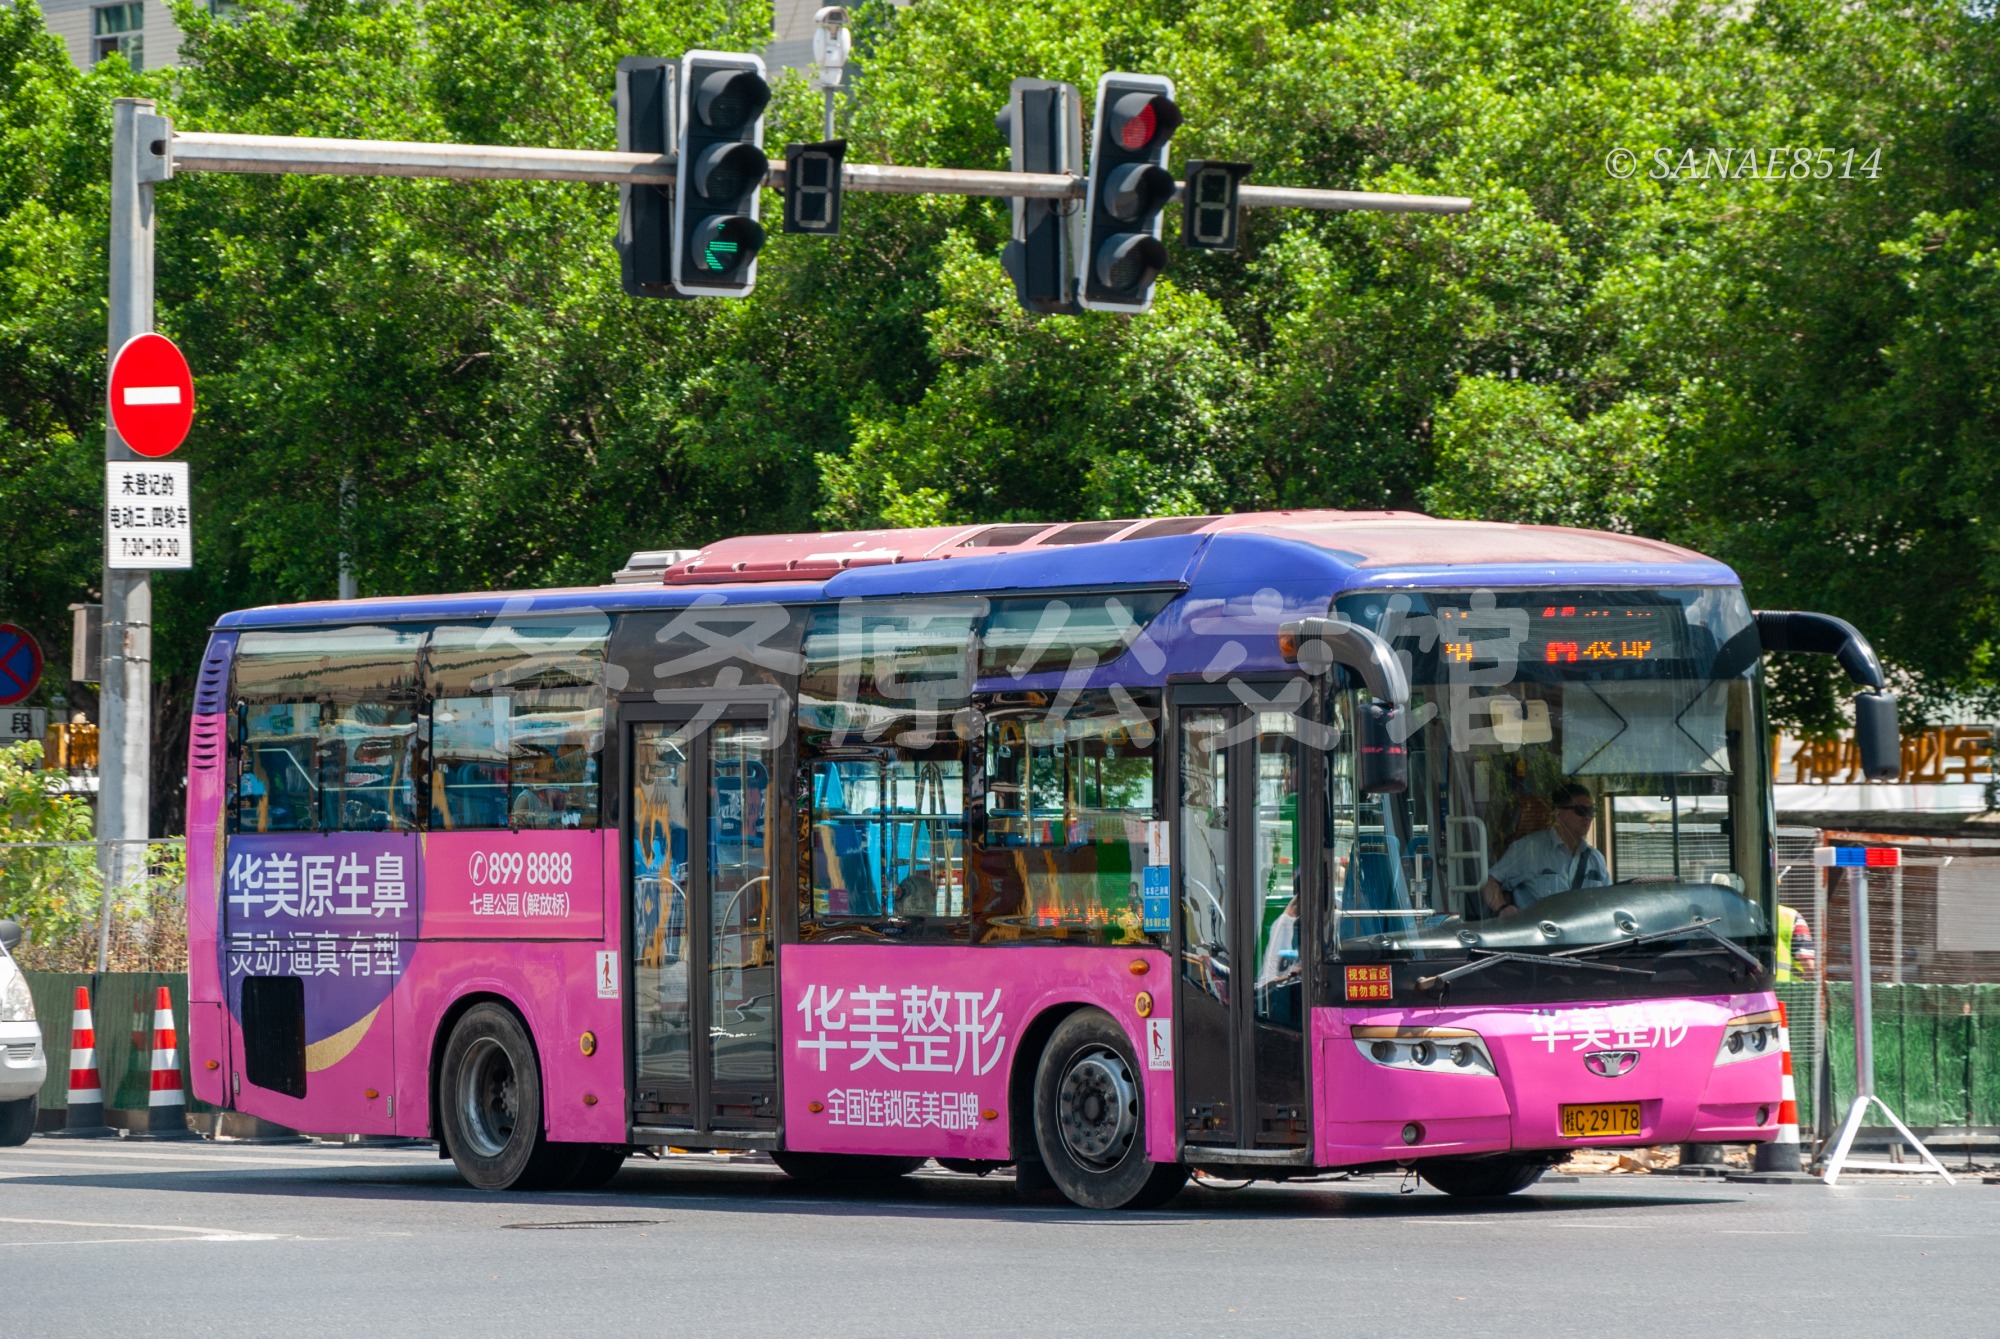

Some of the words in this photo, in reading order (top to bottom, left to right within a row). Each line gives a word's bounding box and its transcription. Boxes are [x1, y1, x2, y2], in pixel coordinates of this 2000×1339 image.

[122, 472, 174, 496] 未登记的
[110, 505, 188, 529] 电动三、四轮车
[121, 537, 180, 557] 7:30-19:30
[489, 852, 524, 885] 899
[526, 852, 573, 885] 8888
[229, 852, 408, 918] 华美原生鼻
[1348, 967, 1388, 980] 视觉盲区
[1348, 984, 1389, 998] 请勿靠近
[797, 984, 1006, 1076] 华美整形
[827, 1088, 979, 1130] 全国连锁医美品牌
